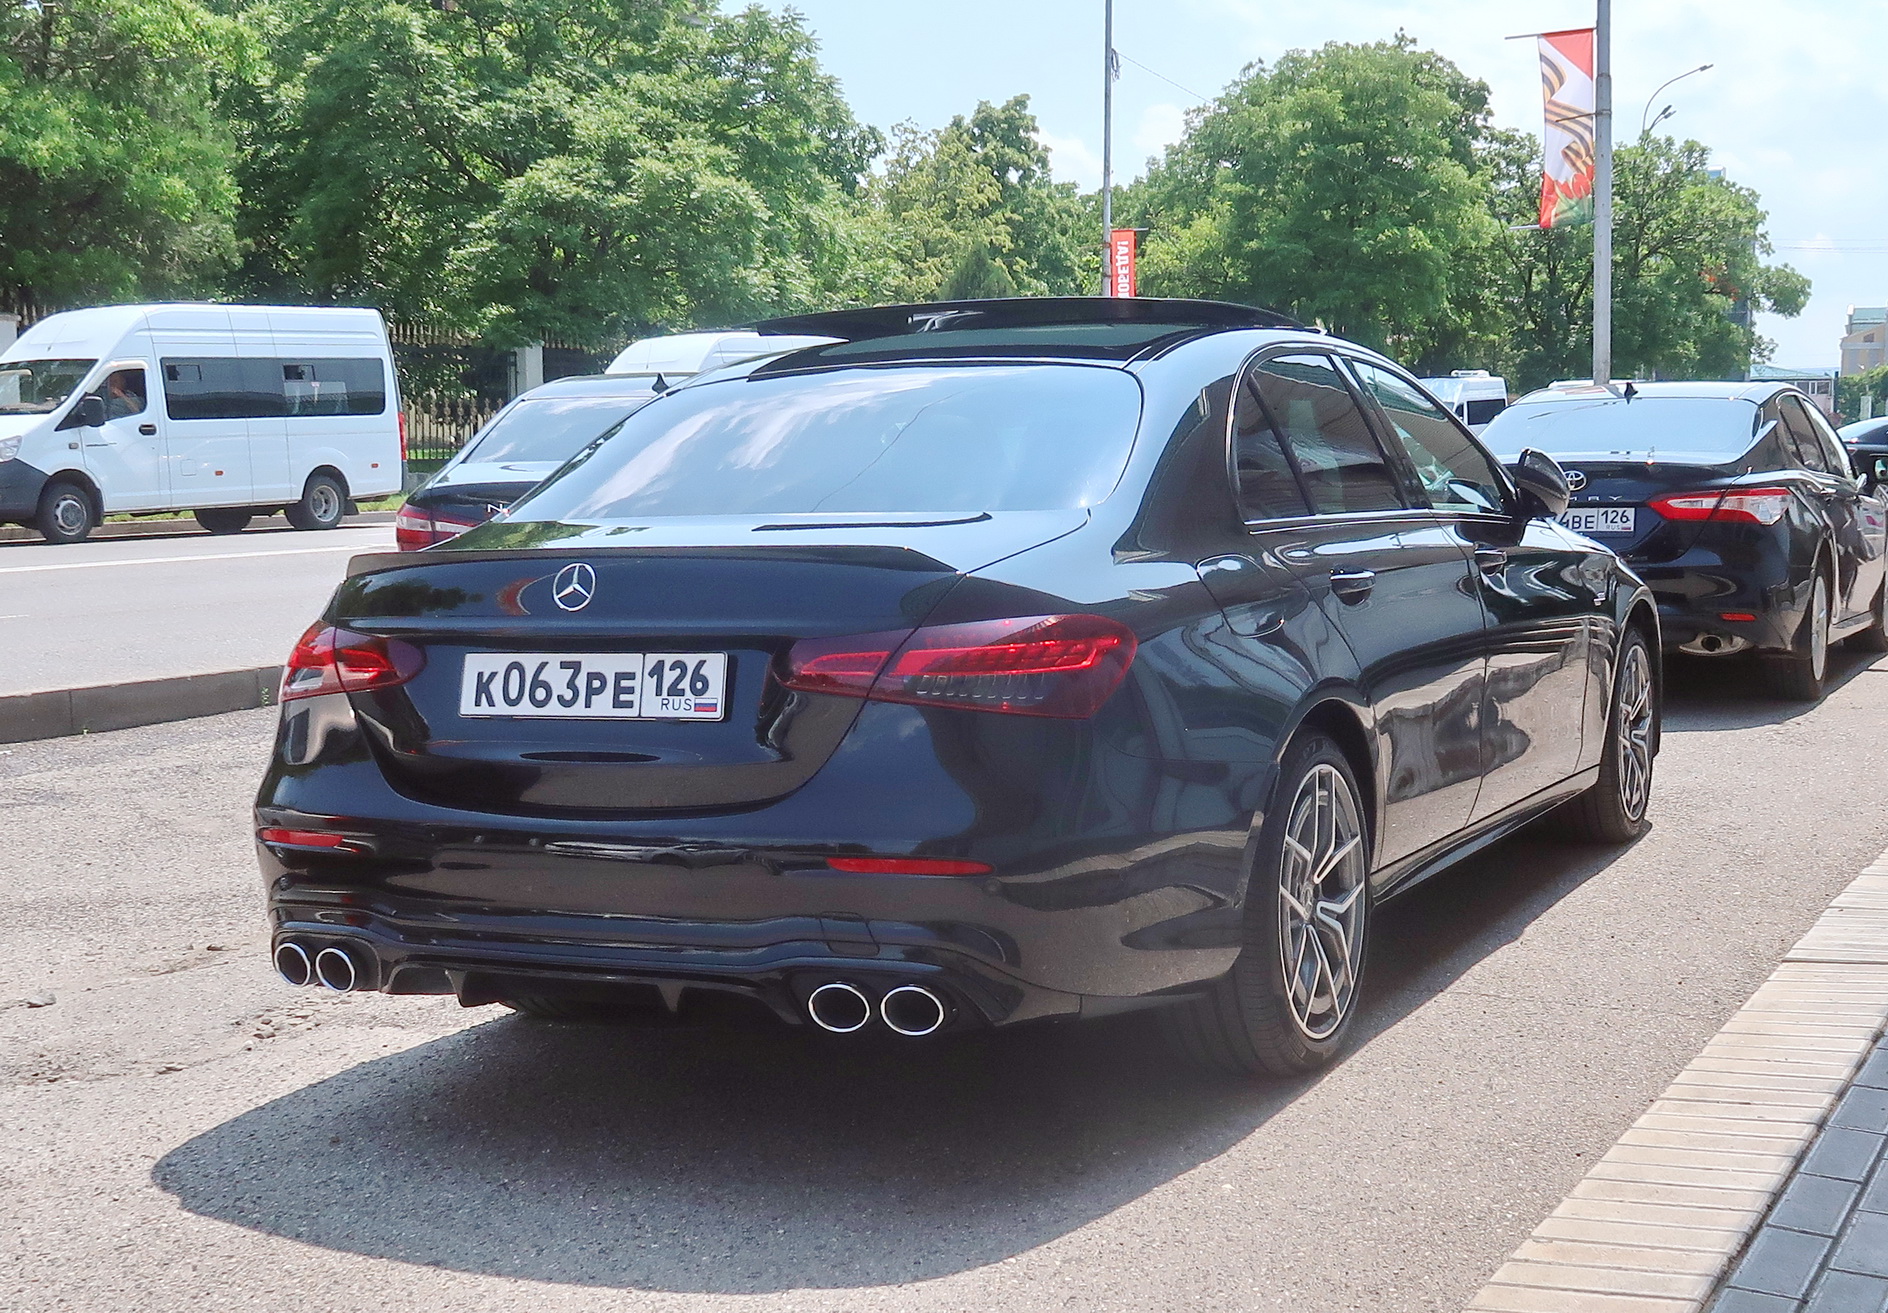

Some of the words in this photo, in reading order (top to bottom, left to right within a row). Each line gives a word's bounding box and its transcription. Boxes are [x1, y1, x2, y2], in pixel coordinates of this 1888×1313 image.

[1601, 509, 1630, 524] 126
[647, 659, 710, 697] 126
[660, 697, 692, 712] RUS
